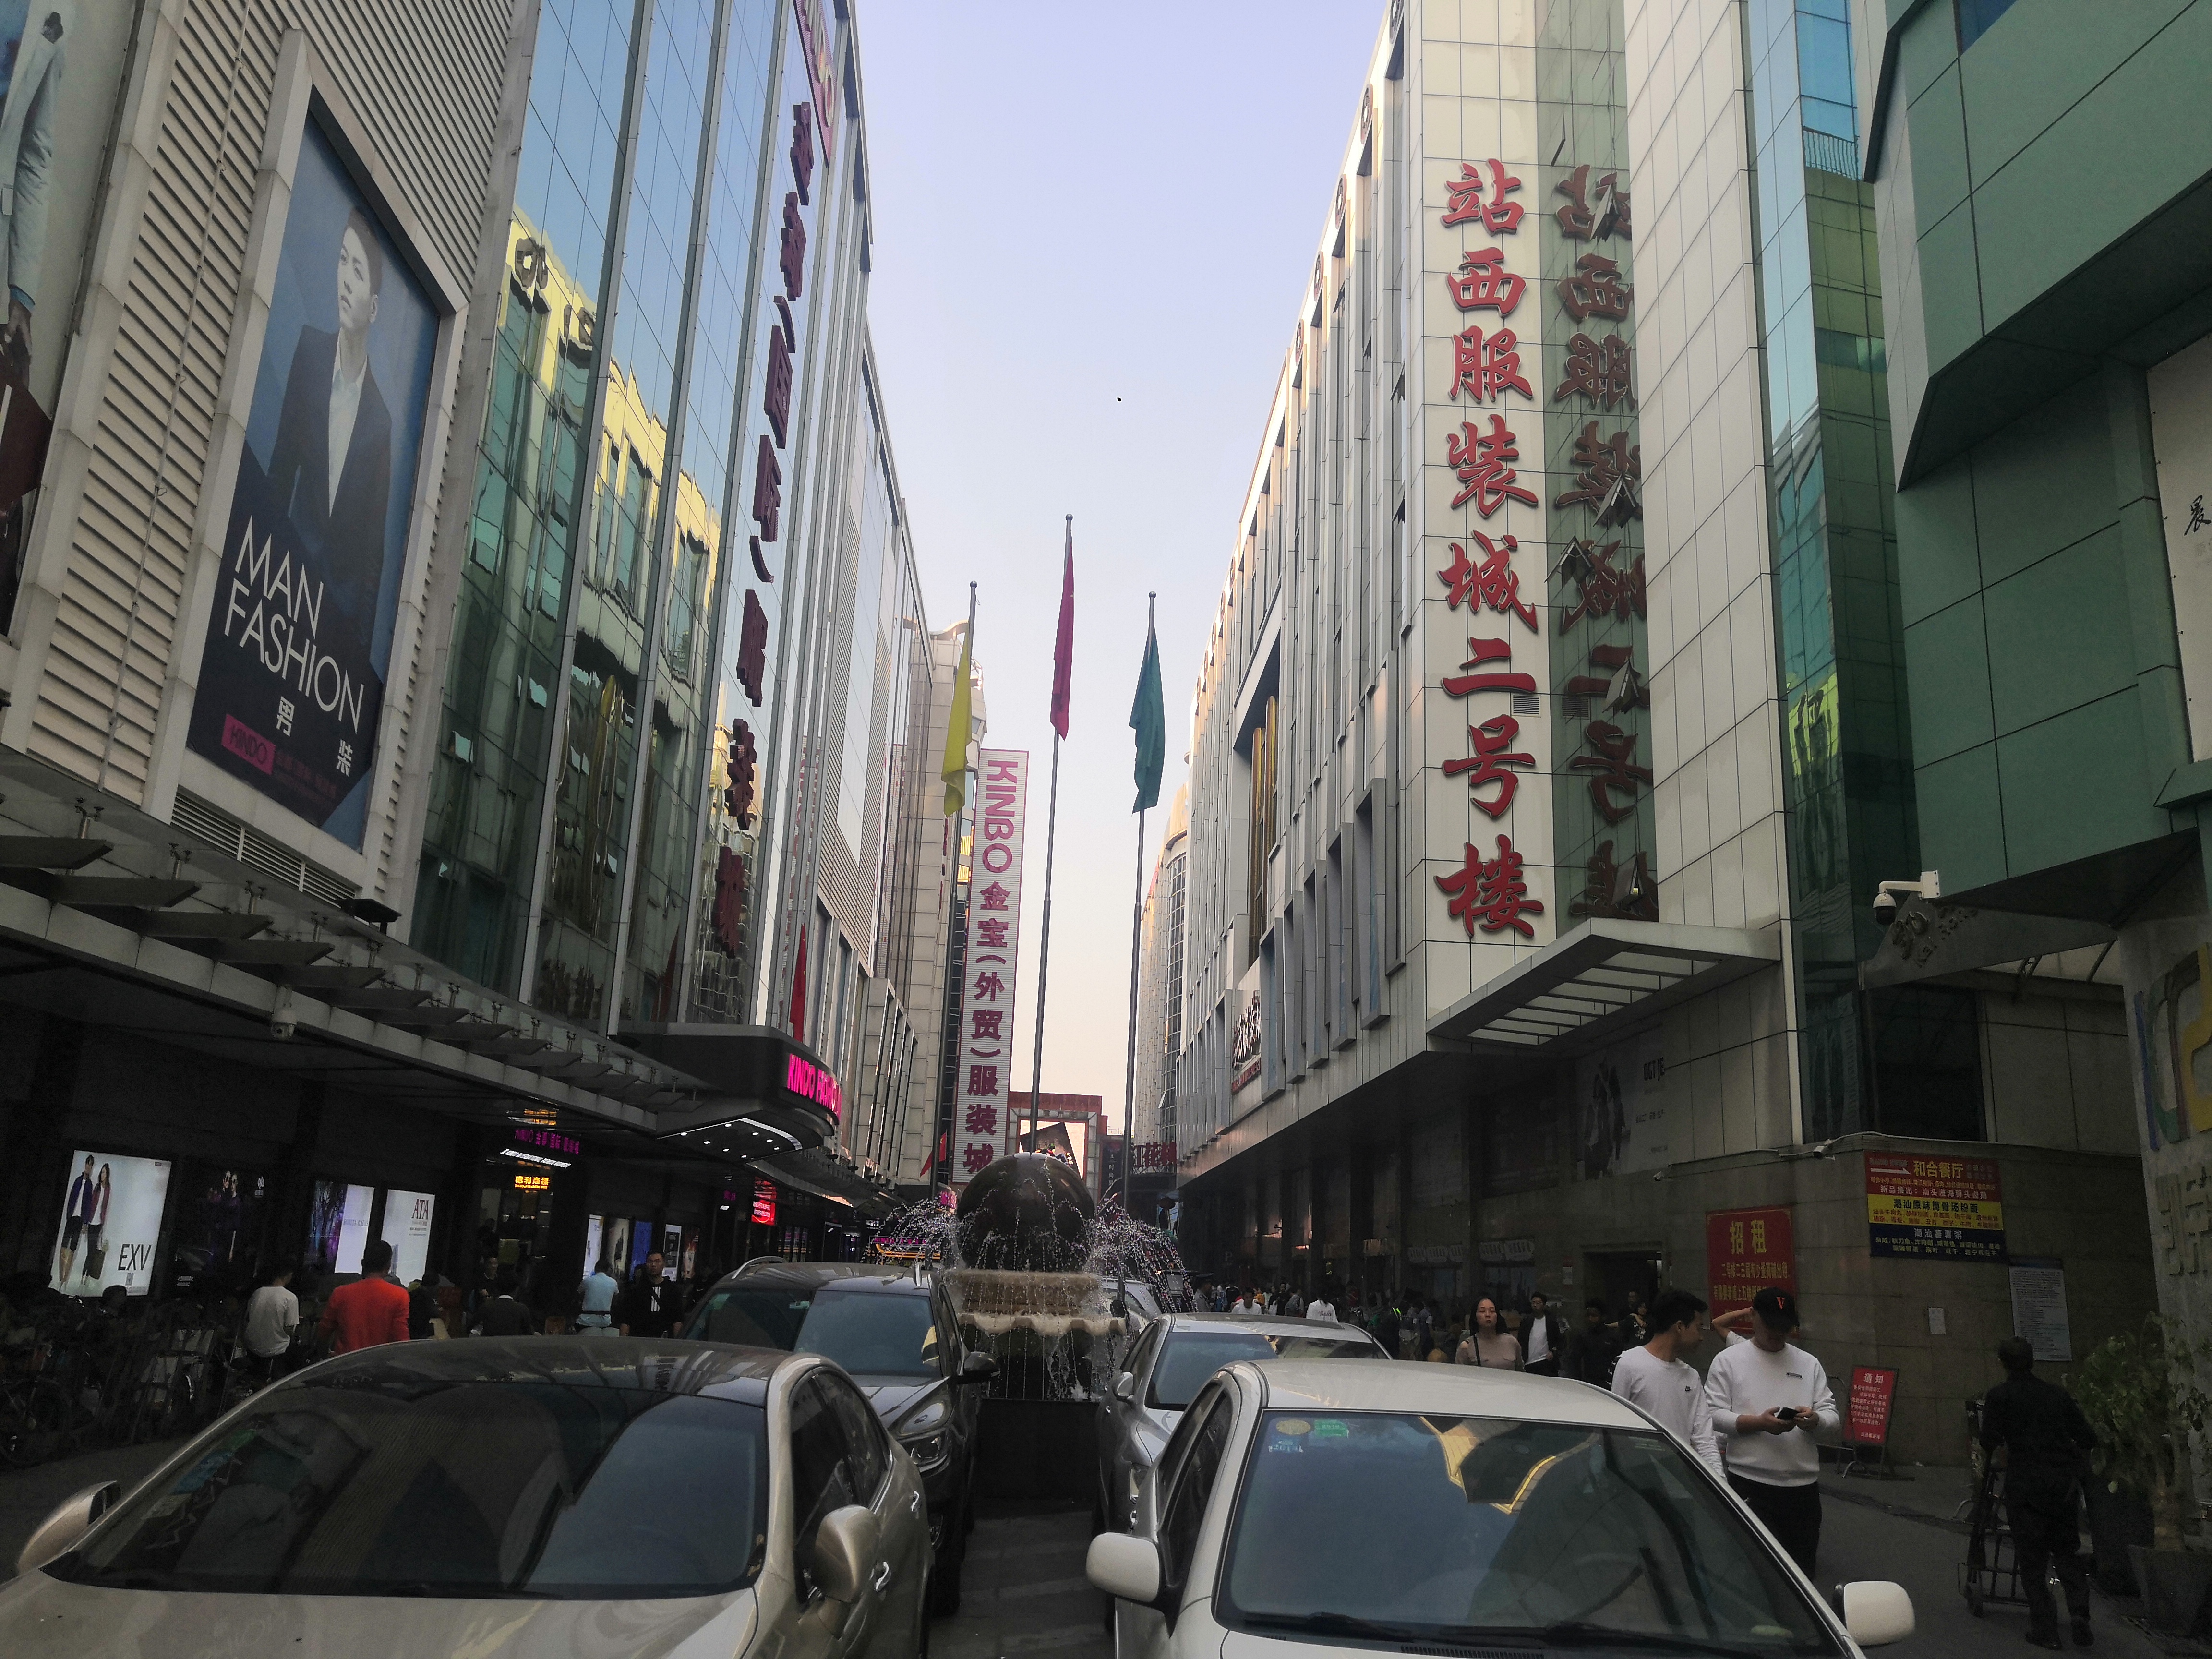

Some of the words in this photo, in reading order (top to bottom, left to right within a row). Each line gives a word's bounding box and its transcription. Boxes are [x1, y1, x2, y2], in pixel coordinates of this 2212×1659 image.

[1434, 158, 1544, 938] 站西服装城二号楼
[235, 515, 324, 639] MAN
[225, 577, 364, 734] FASHION
[982, 760, 1018, 873] KINBO
[787, 1053, 816, 1099] KINDO
[1913, 1160, 1963, 1178] 和合餐厅
[411, 1198, 429, 1220] ATA
[1730, 1219, 1767, 1254] 招租
[118, 1243, 152, 1271] EXV
[1863, 1372, 1884, 1384] 通知
